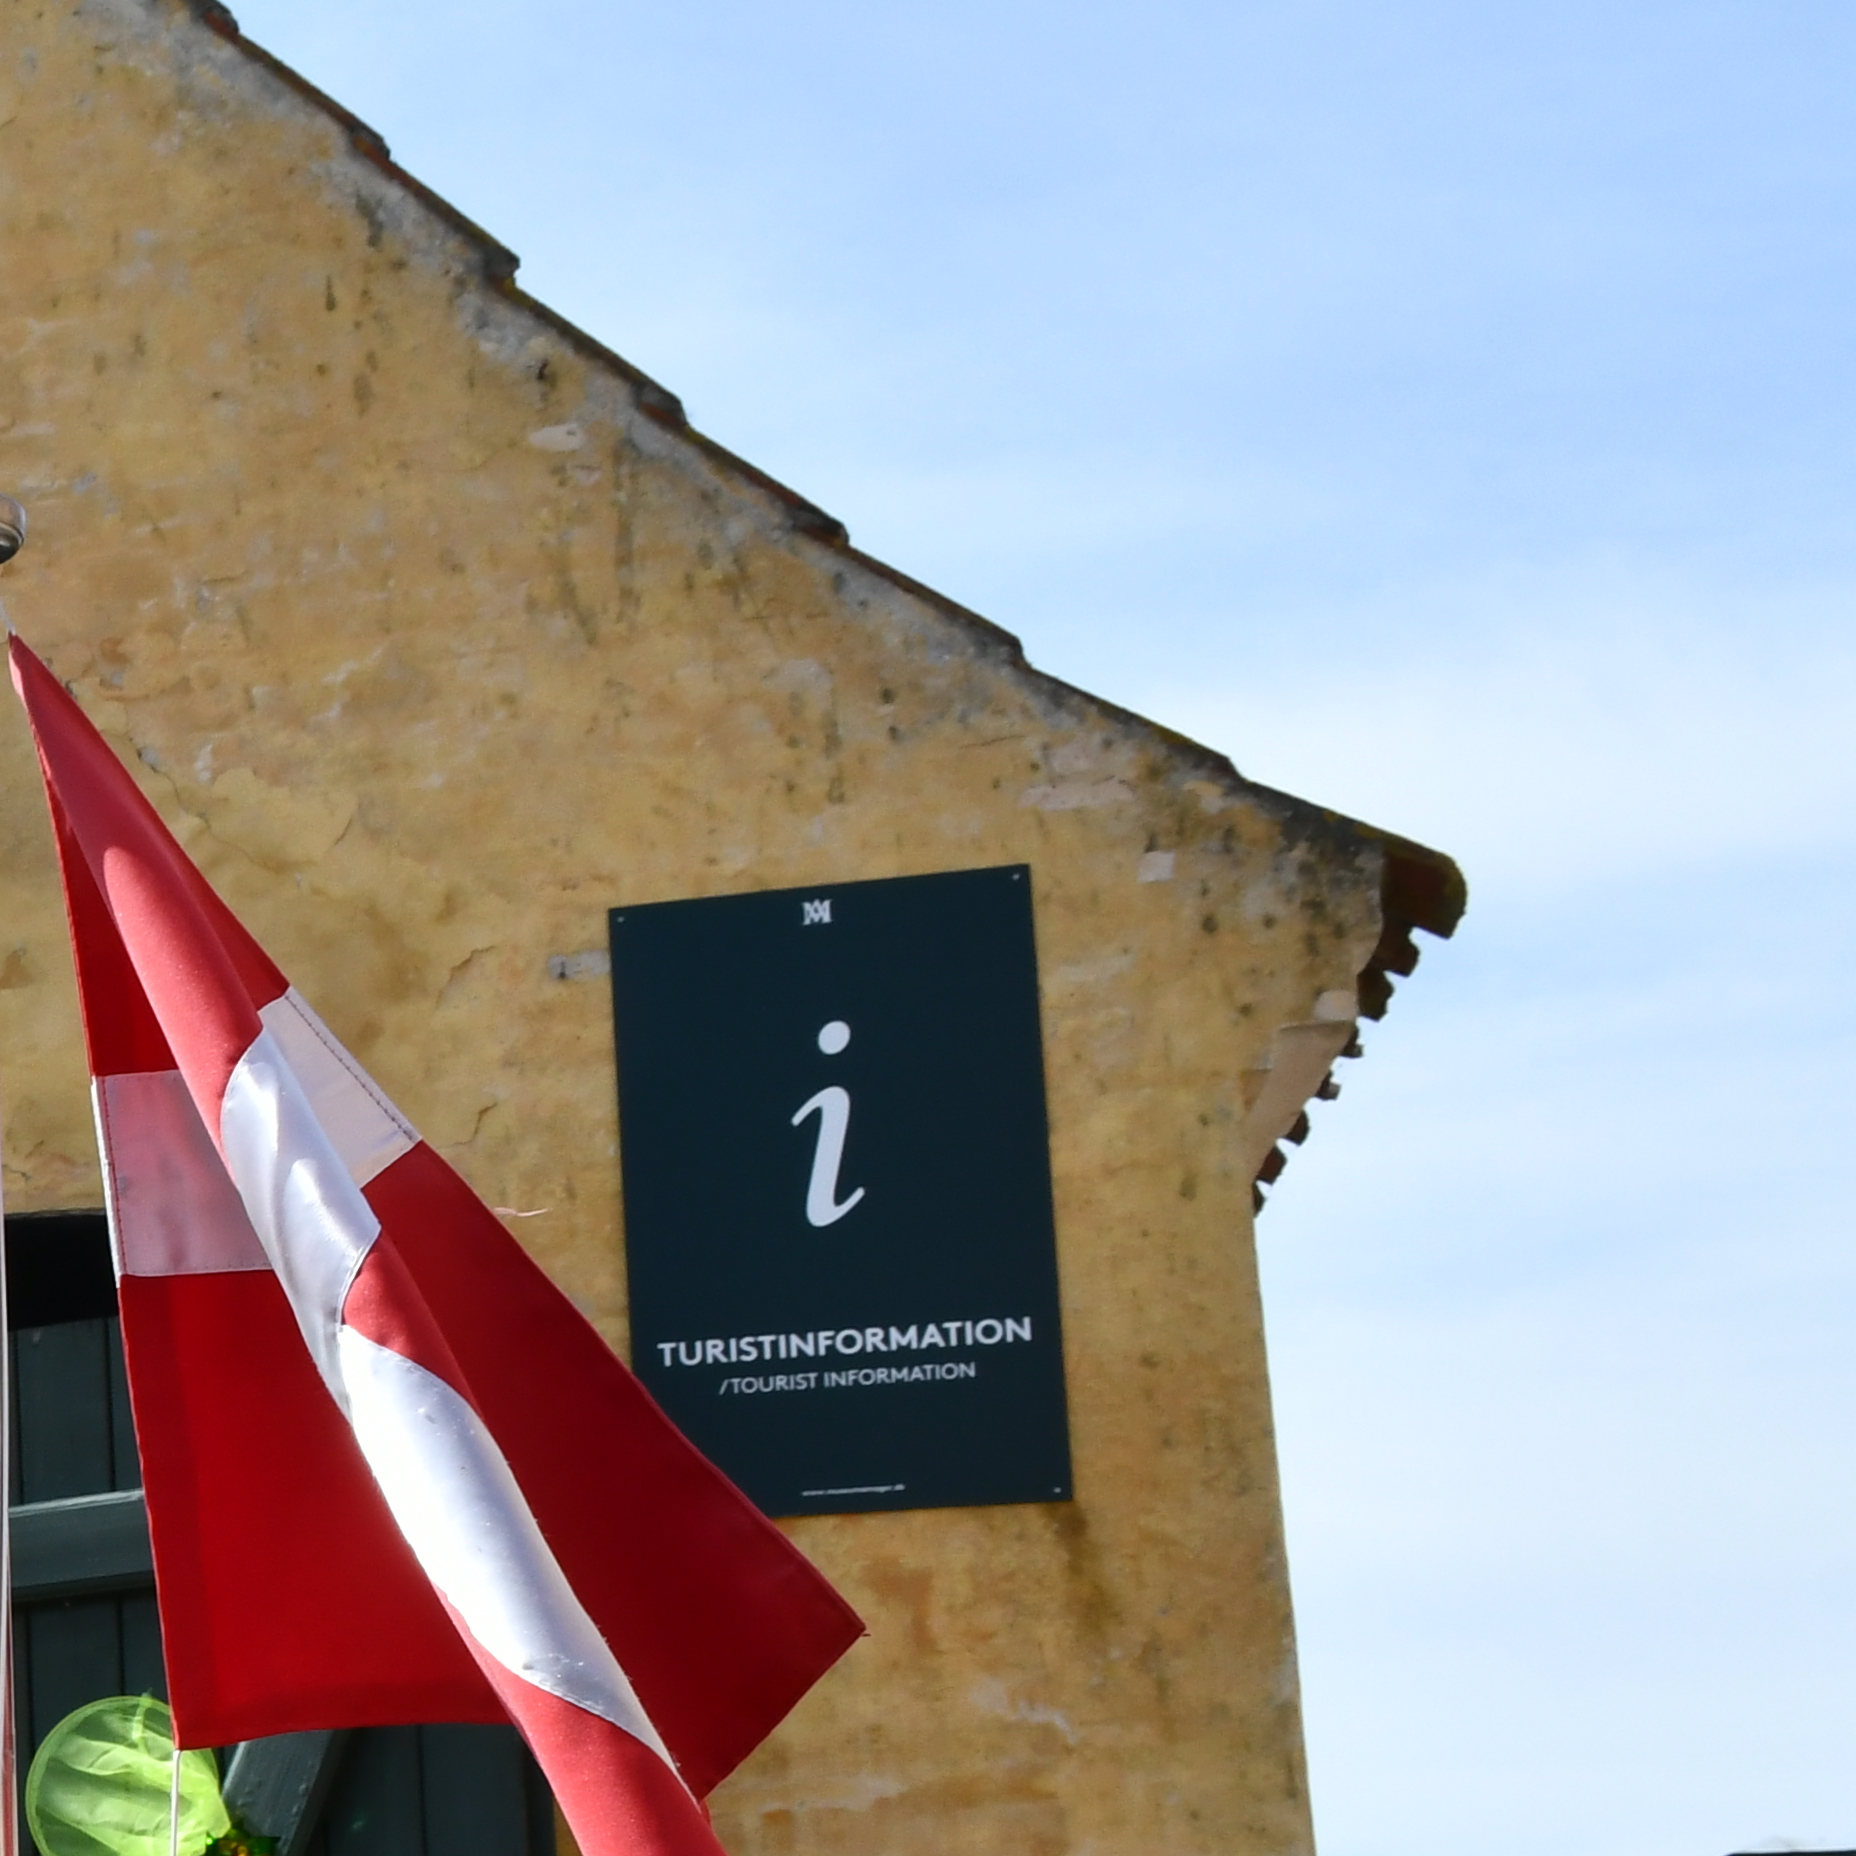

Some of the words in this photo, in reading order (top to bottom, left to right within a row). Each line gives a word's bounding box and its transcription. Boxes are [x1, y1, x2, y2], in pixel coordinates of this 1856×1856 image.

[657, 1316, 1032, 1367] TURISTINFORMATION
[719, 1372, 818, 1395] /TOURIST
[823, 1362, 976, 1388] INFORMATION
